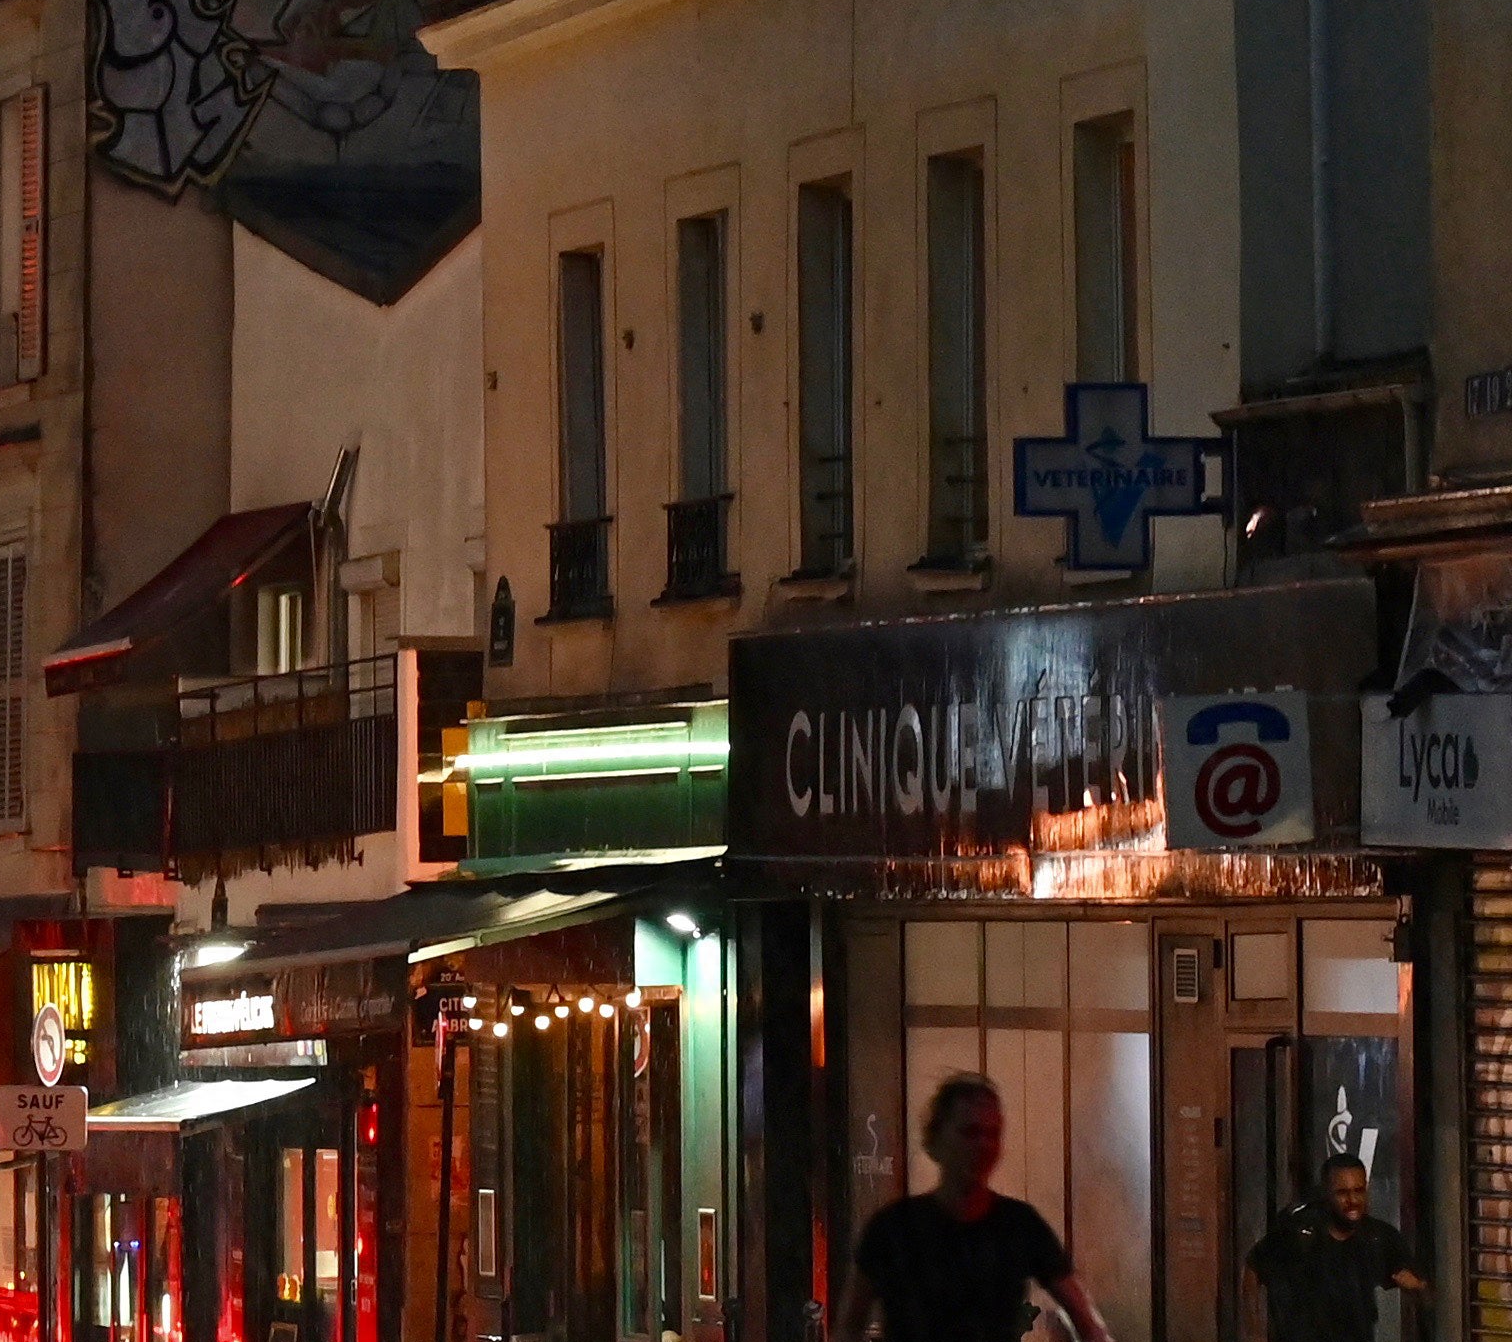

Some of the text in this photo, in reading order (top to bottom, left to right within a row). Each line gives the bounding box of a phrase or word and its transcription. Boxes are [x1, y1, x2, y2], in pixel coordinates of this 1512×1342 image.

[785, 700, 979, 818] CLINIQUE
[1399, 719, 1460, 802] Lyca
[17, 1093, 65, 1109] SAUF
